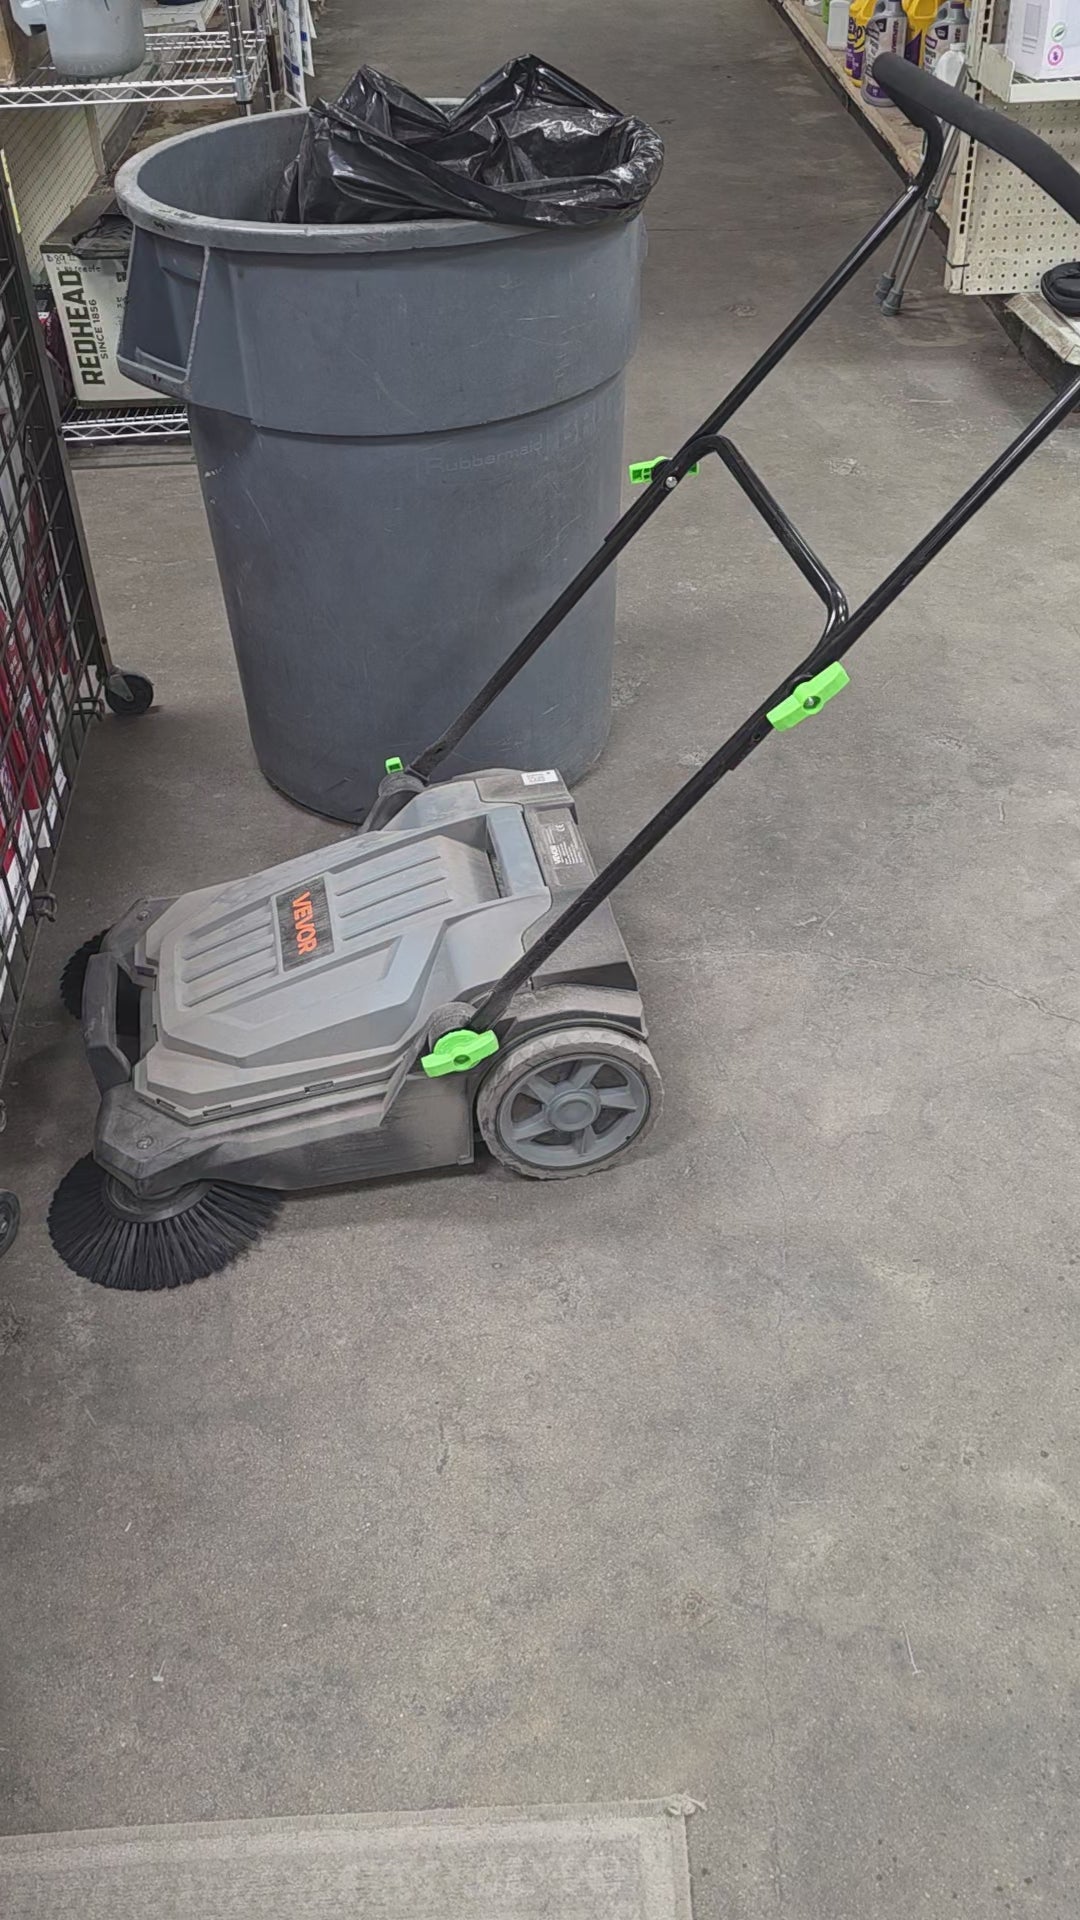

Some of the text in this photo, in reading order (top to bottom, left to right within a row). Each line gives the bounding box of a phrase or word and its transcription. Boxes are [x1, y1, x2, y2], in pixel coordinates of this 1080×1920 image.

[57, 270, 106, 385] REDHEAD
[88, 299, 109, 359] SINCE 1856
[425, 433, 544, 475] Rubbermaid
[292, 891, 318, 955] VEVOR
